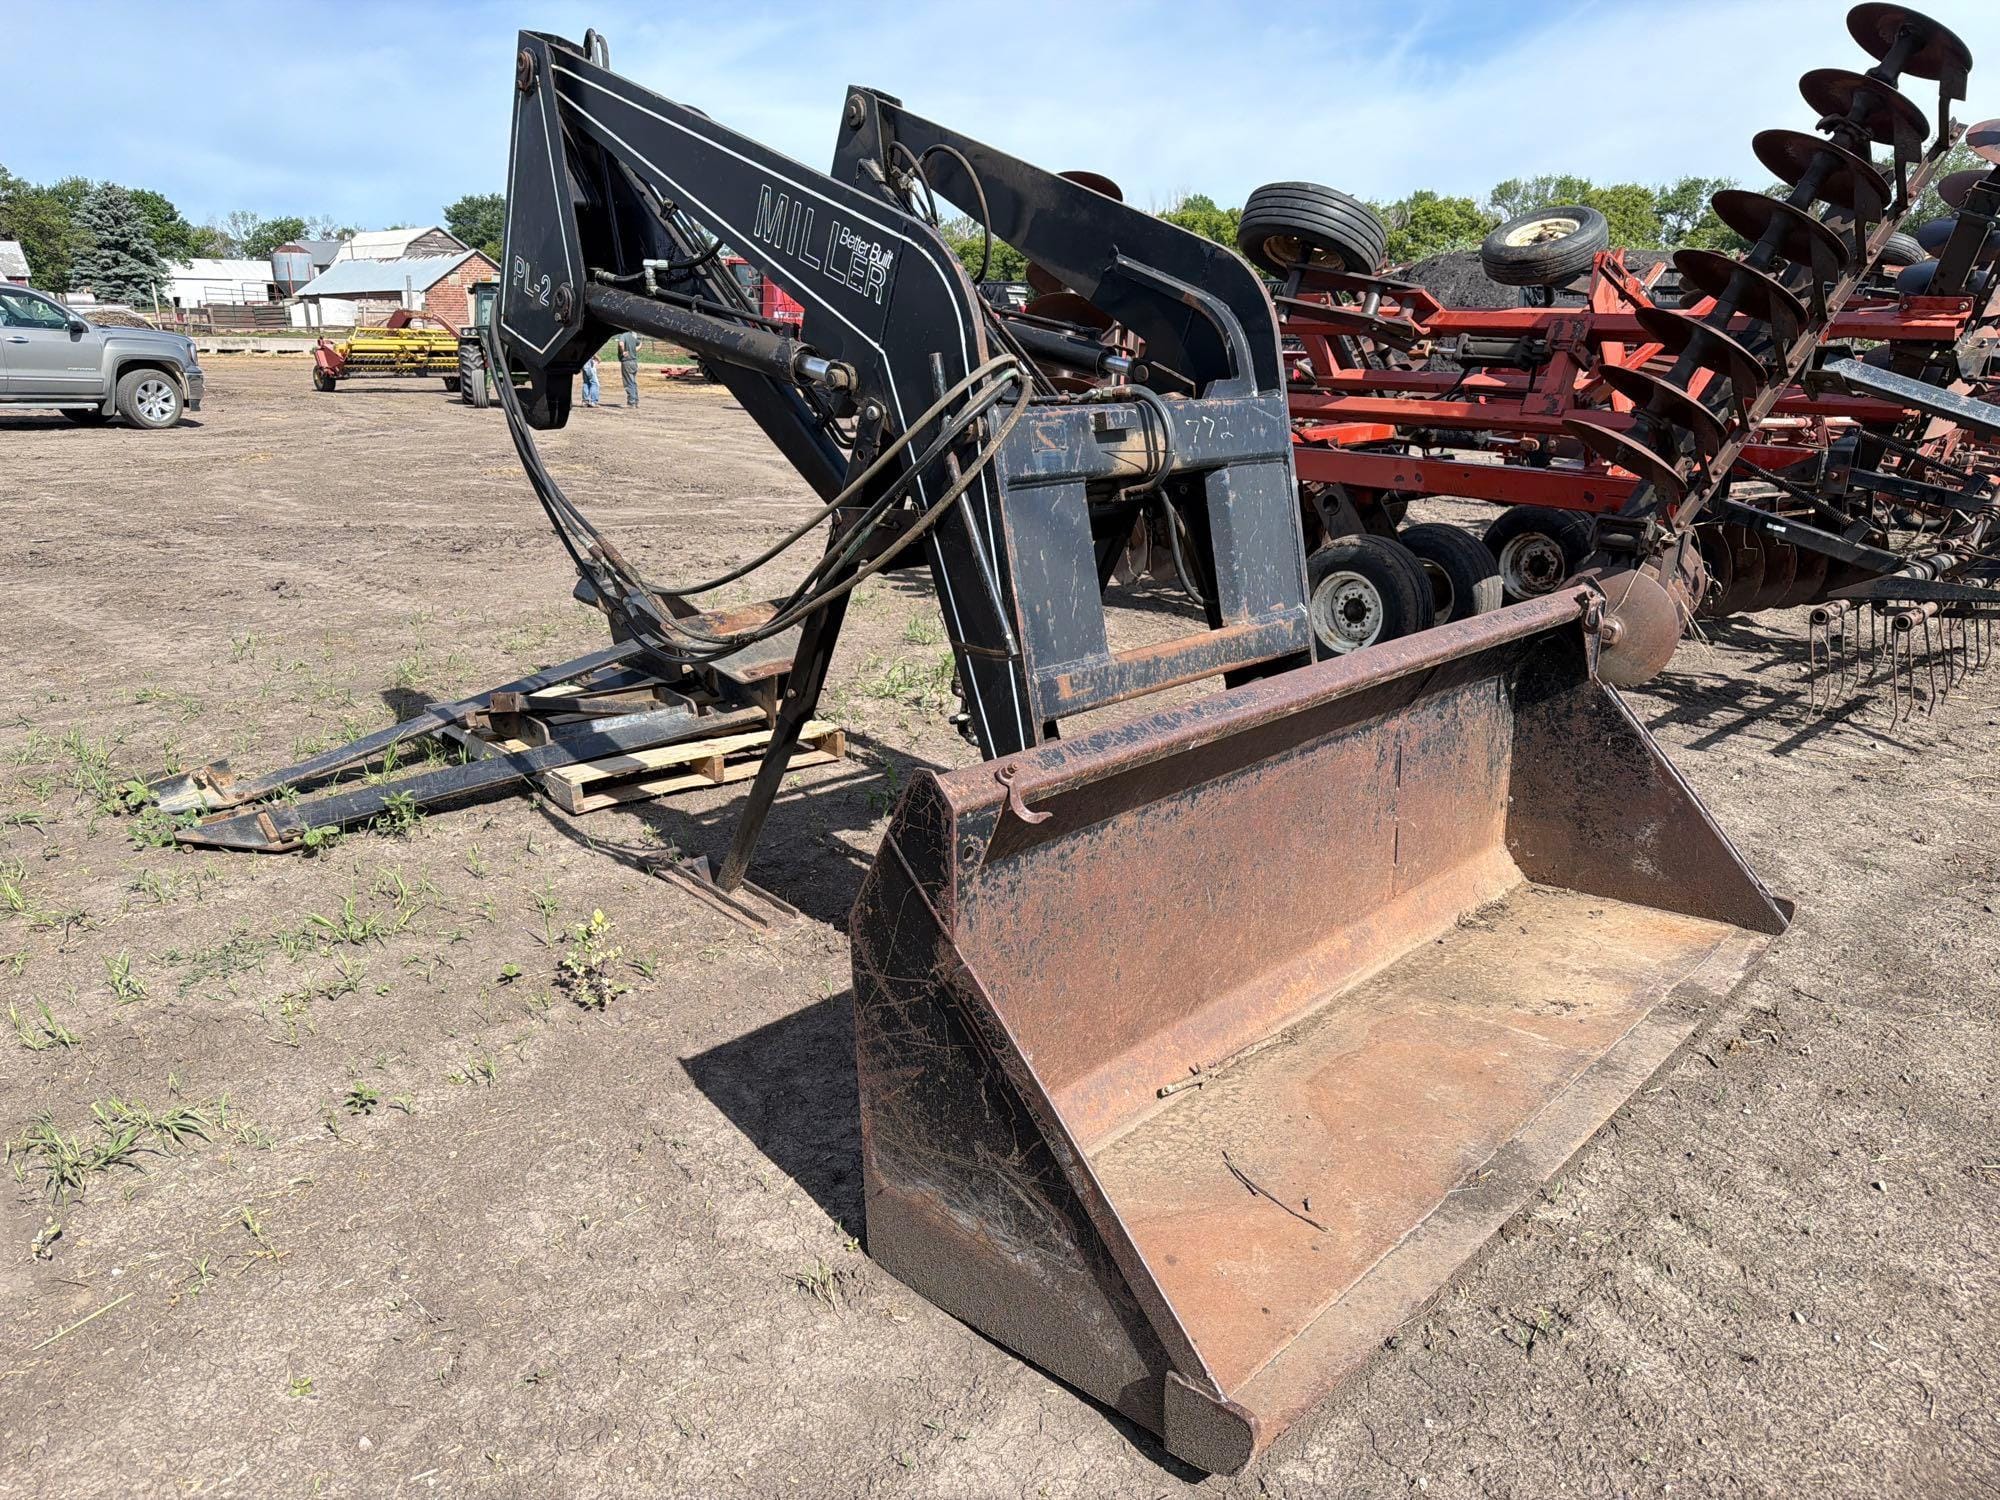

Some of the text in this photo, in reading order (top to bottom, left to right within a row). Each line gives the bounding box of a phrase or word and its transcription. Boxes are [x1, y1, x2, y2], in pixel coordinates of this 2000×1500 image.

[753, 183, 887, 305] MILLER
[839, 226, 894, 270] Better Built
[513, 255, 551, 307] PL-2
[1185, 415, 1234, 444] 772
